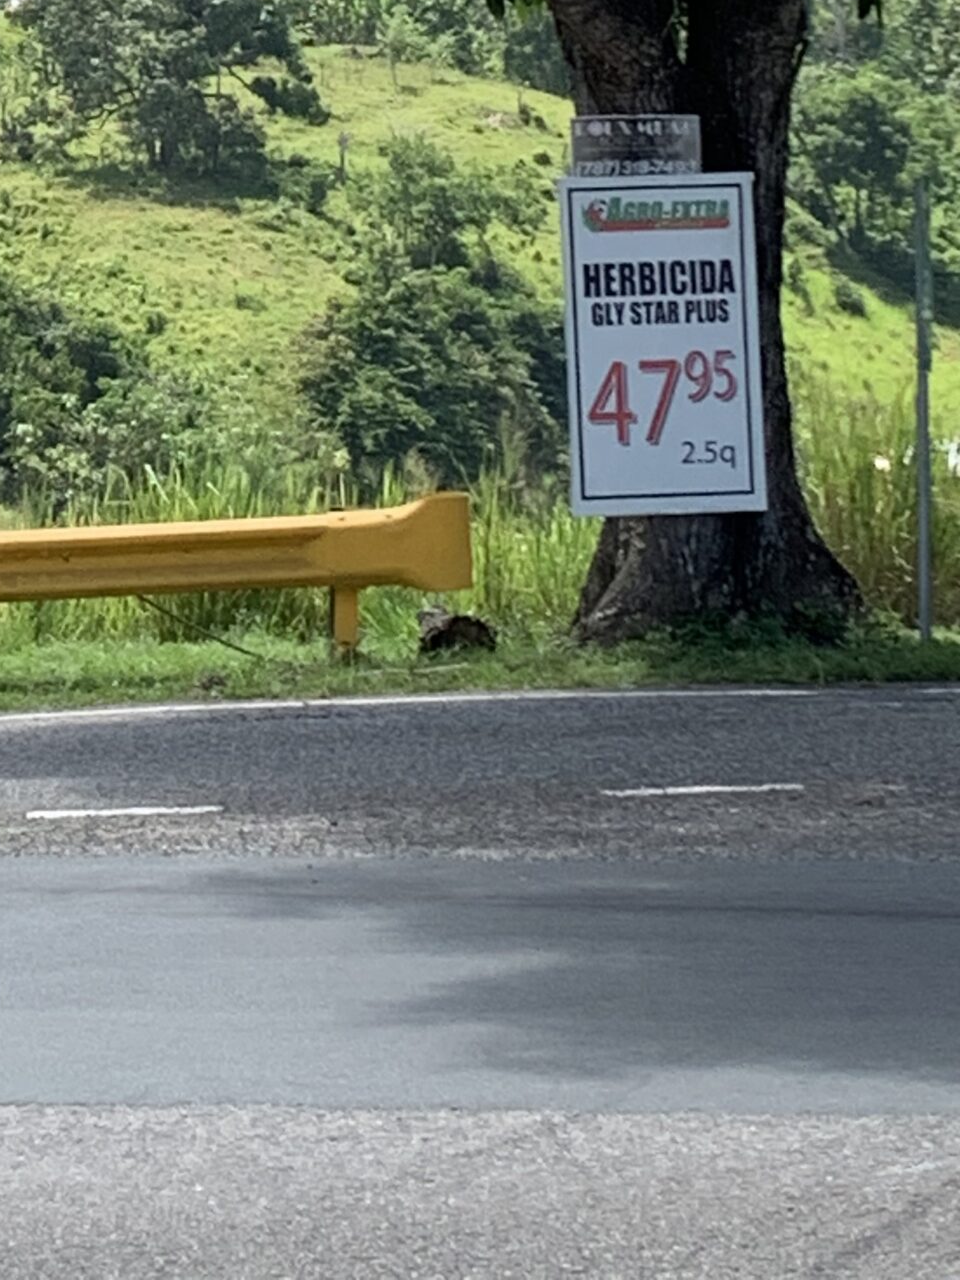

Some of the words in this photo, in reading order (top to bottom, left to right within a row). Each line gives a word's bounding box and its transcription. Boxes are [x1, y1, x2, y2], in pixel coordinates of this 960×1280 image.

[583, 259, 736, 298] HERBICIDA
[592, 302, 626, 326] GLY
[629, 300, 680, 325] STAR
[685, 299, 730, 324] PLUS
